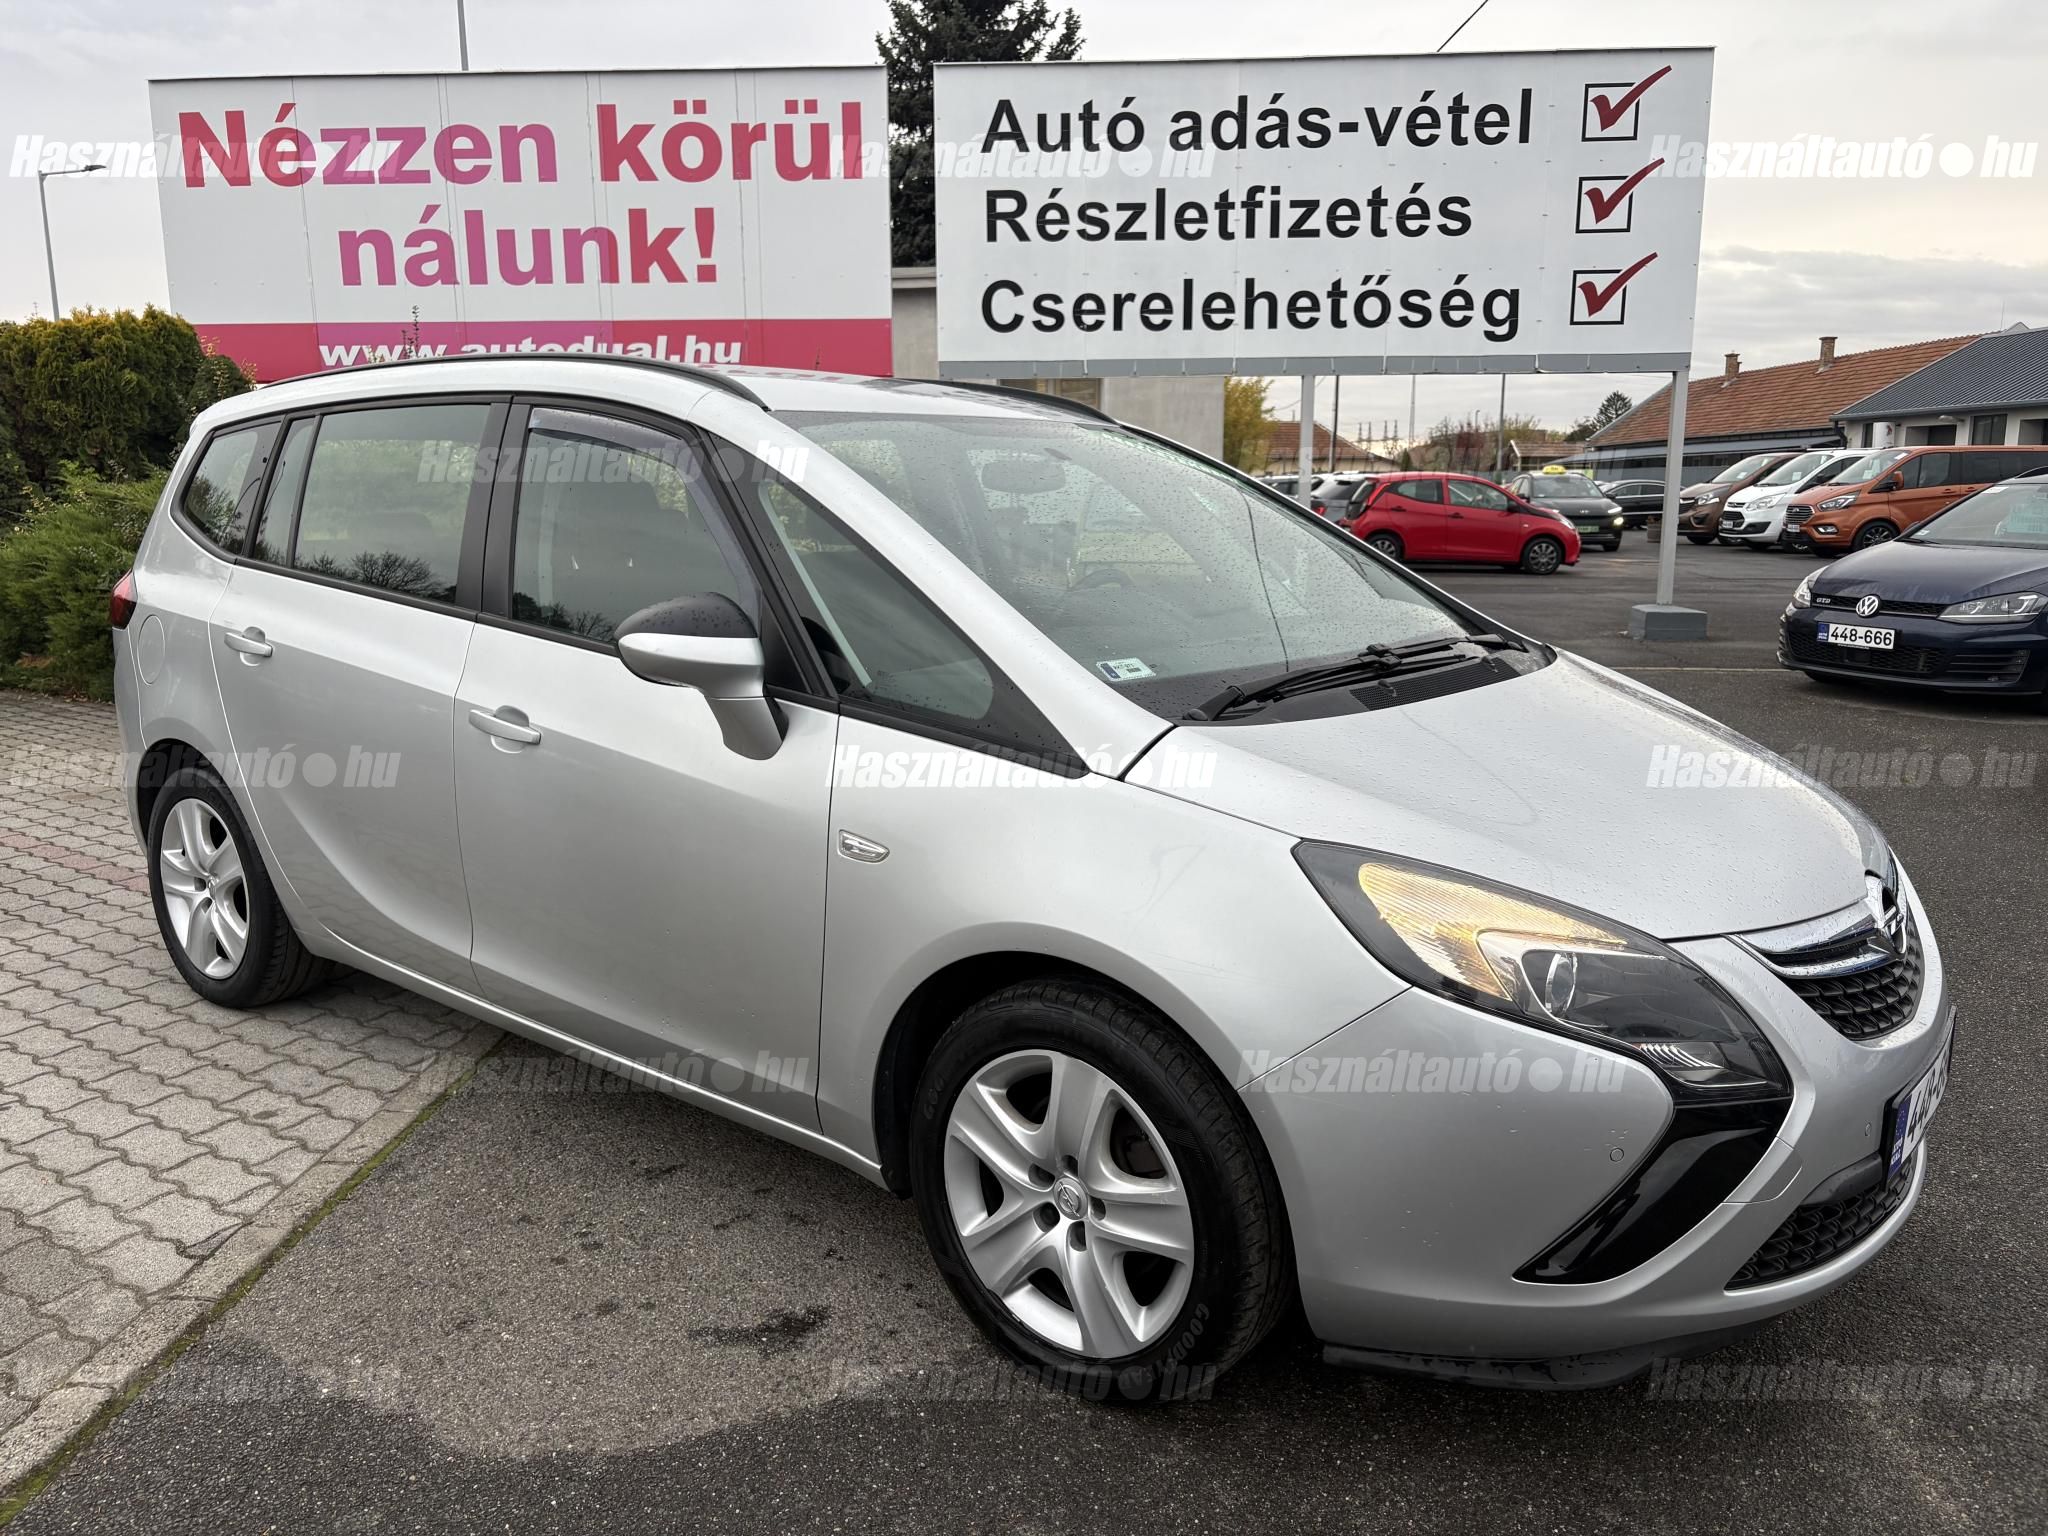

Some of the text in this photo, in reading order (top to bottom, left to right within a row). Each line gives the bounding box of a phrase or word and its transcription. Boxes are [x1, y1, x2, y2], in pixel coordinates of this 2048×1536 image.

[179, 99, 863, 188] Nézzen körül
[982, 89, 1531, 153] Autó adás-vétel
[339, 205, 718, 286] nálunk!
[987, 183, 1471, 242] Részletfizetés
[982, 274, 1520, 342] Cserelehetőség
[1830, 626, 1893, 646] 448-666
